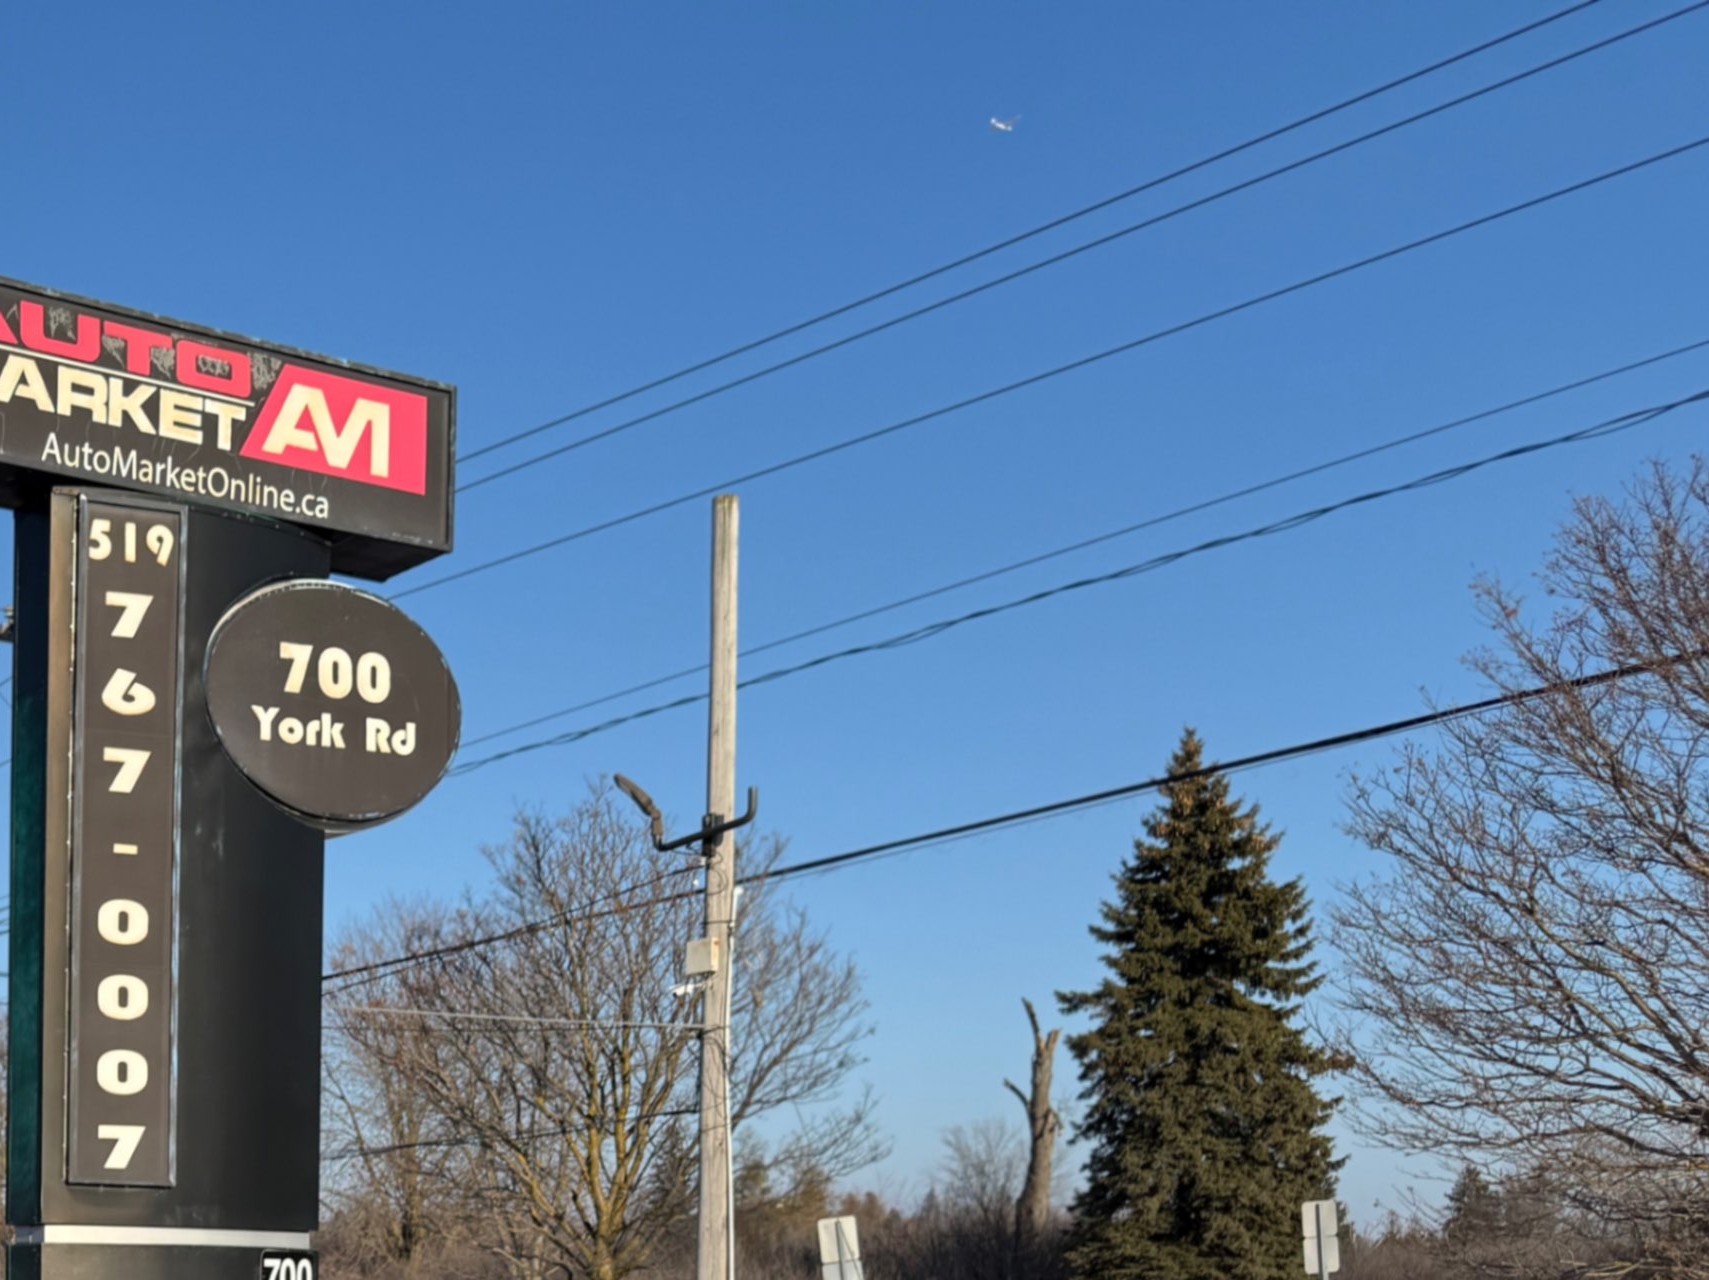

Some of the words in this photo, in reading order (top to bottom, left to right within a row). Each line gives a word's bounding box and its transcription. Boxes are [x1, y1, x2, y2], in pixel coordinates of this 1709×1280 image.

[41, 432, 329, 519] AutoMarketOnline.ca
[88, 518, 174, 566] 519
[279, 641, 392, 704] 700
[251, 704, 347, 749] York
[365, 717, 416, 756] Rd
